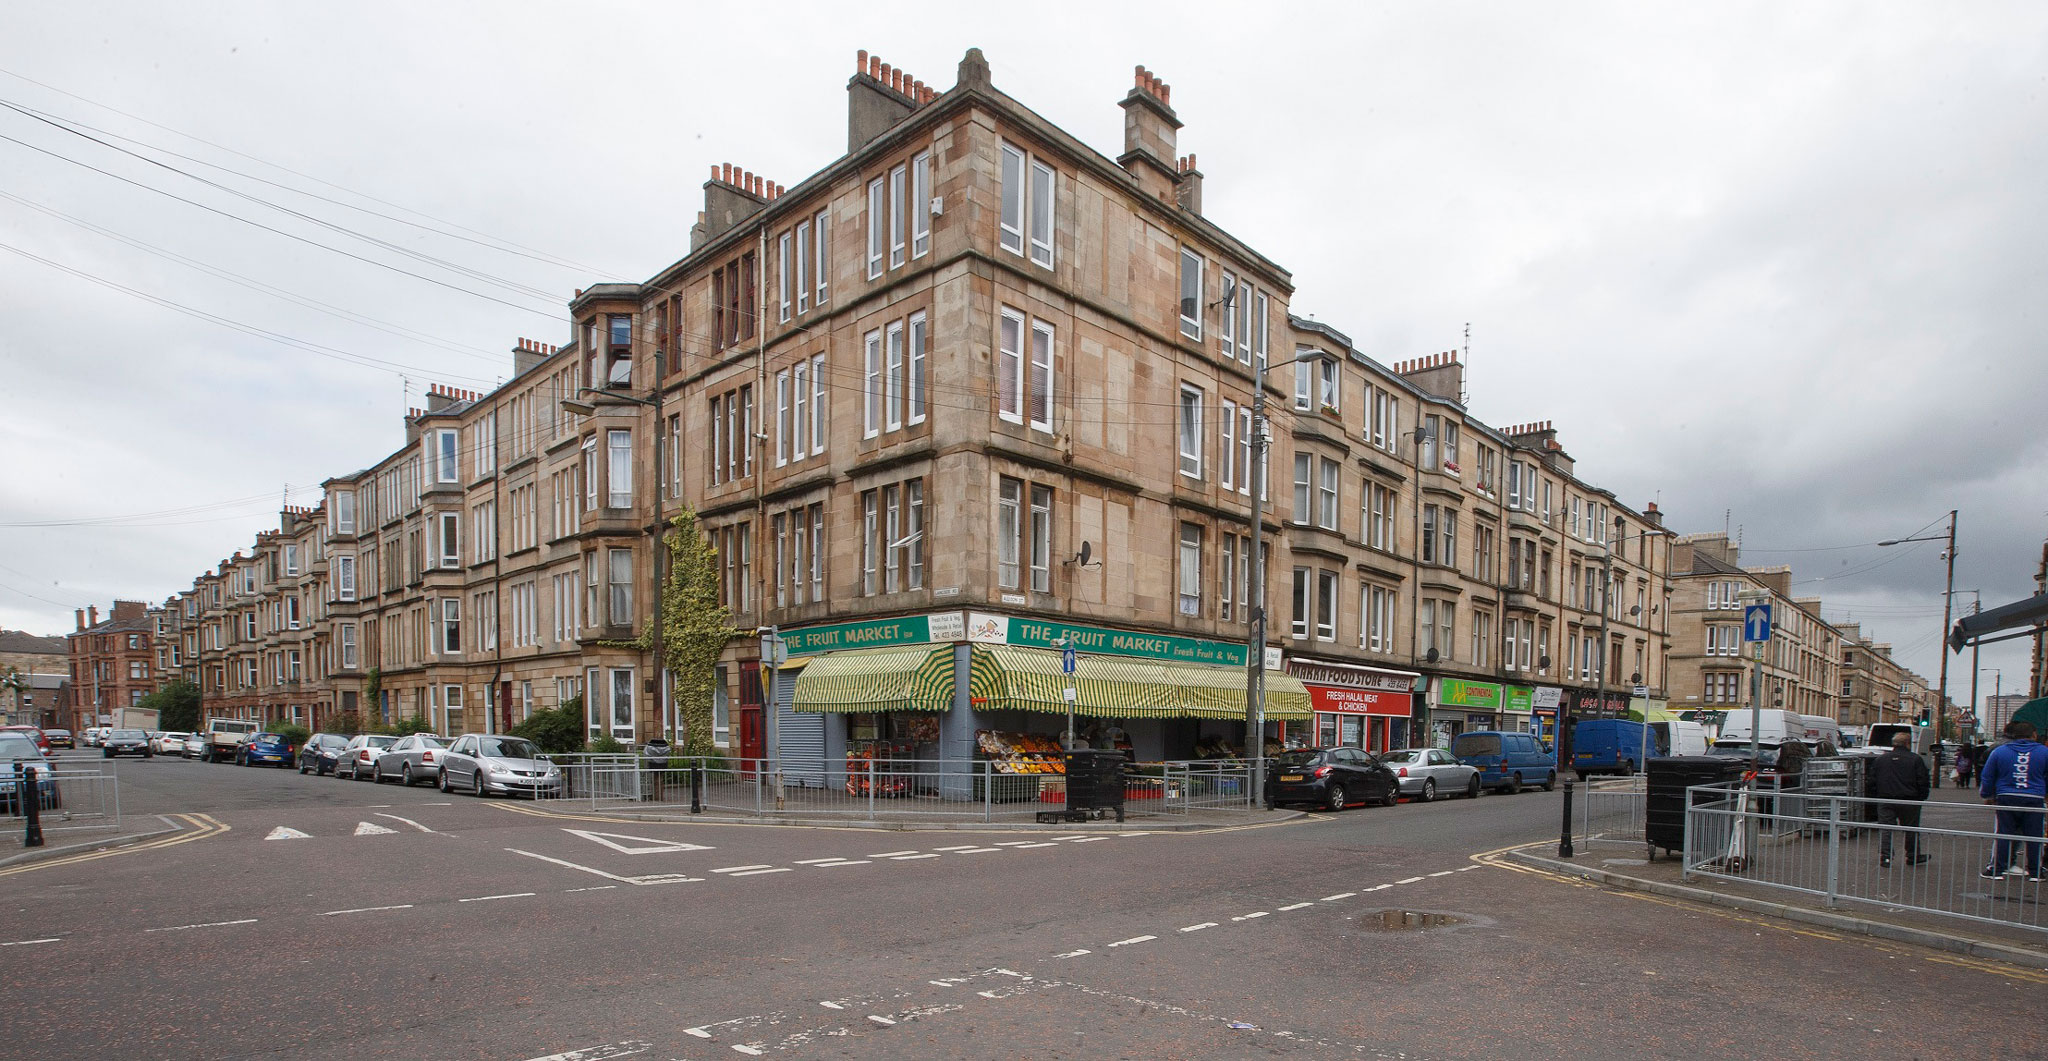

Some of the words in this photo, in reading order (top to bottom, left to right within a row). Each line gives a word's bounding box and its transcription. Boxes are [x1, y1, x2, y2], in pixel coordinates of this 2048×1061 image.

[807, 631, 840, 646] FRUIT
[845, 624, 900, 643] MARKET
[1021, 625, 1052, 641] THE
[1061, 629, 1106, 647] FRUIT
[1112, 635, 1170, 654] MARKET
[1174, 645, 1194, 657] Fresh
[1197, 649, 1213, 660] Fruit
[1217, 652, 1223, 660] &
[1227, 652, 1239, 664] Veg
[1291, 664, 1326, 681] MAKKA
[1328, 670, 1354, 685] FOOD
[1356, 673, 1382, 687] STORE
[1326, 690, 1346, 701] FRESH
[1346, 692, 1364, 702] HALAL
[1364, 693, 1378, 703] MEAT
[1338, 701, 1343, 710] &
[1343, 702, 1367, 712] CHICKEN
